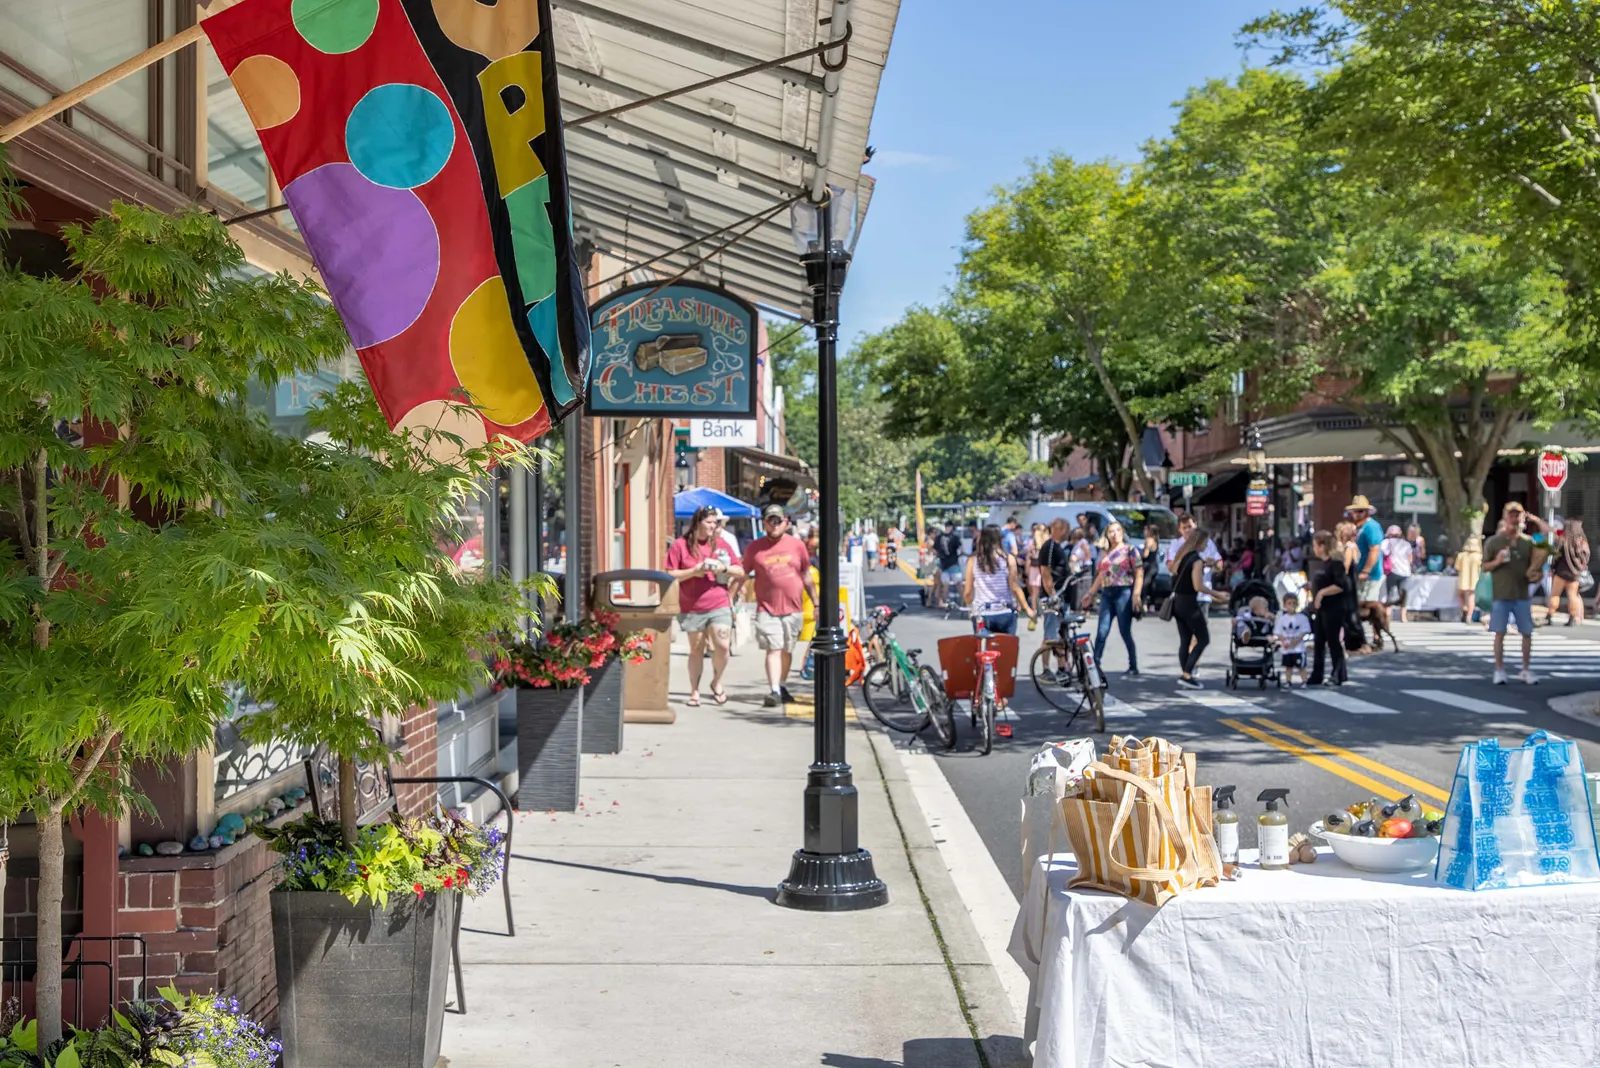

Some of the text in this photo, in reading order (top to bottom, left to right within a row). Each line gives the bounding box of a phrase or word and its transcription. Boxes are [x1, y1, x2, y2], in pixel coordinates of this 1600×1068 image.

[600, 297, 748, 349] TREASURE
[593, 361, 745, 405] CHEST
[703, 420, 743, 437] Bank
[1541, 459, 1566, 477] STOP
[1400, 484, 1418, 505] P
